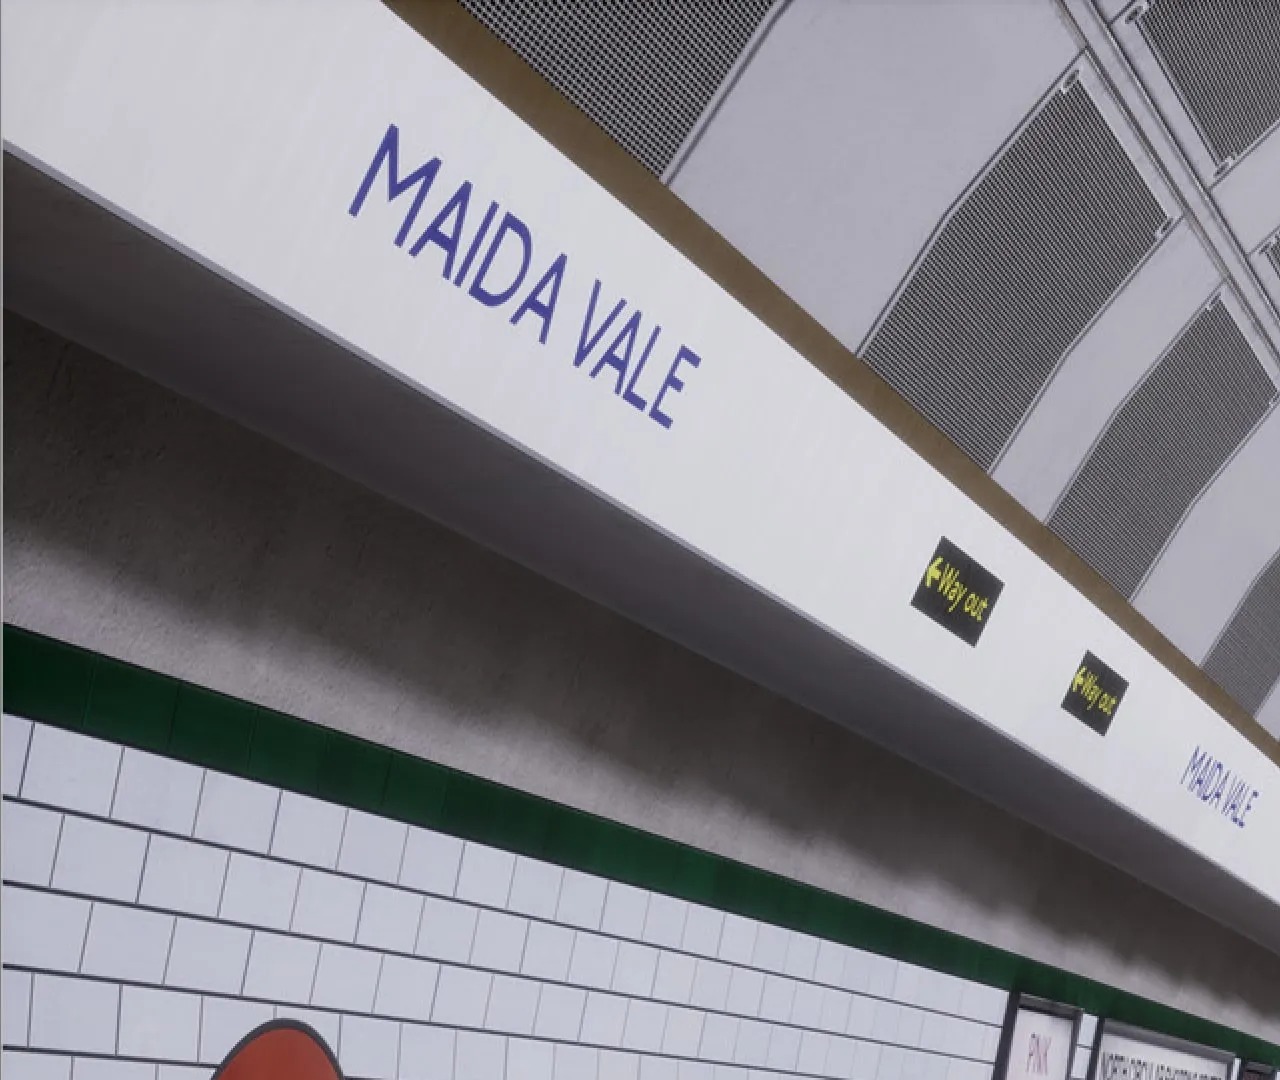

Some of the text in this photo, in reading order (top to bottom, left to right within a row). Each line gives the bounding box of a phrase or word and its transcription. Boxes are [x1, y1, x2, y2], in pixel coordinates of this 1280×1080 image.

[348, 123, 702, 430] MAIDA VALE
[937, 563, 989, 622] Way out
